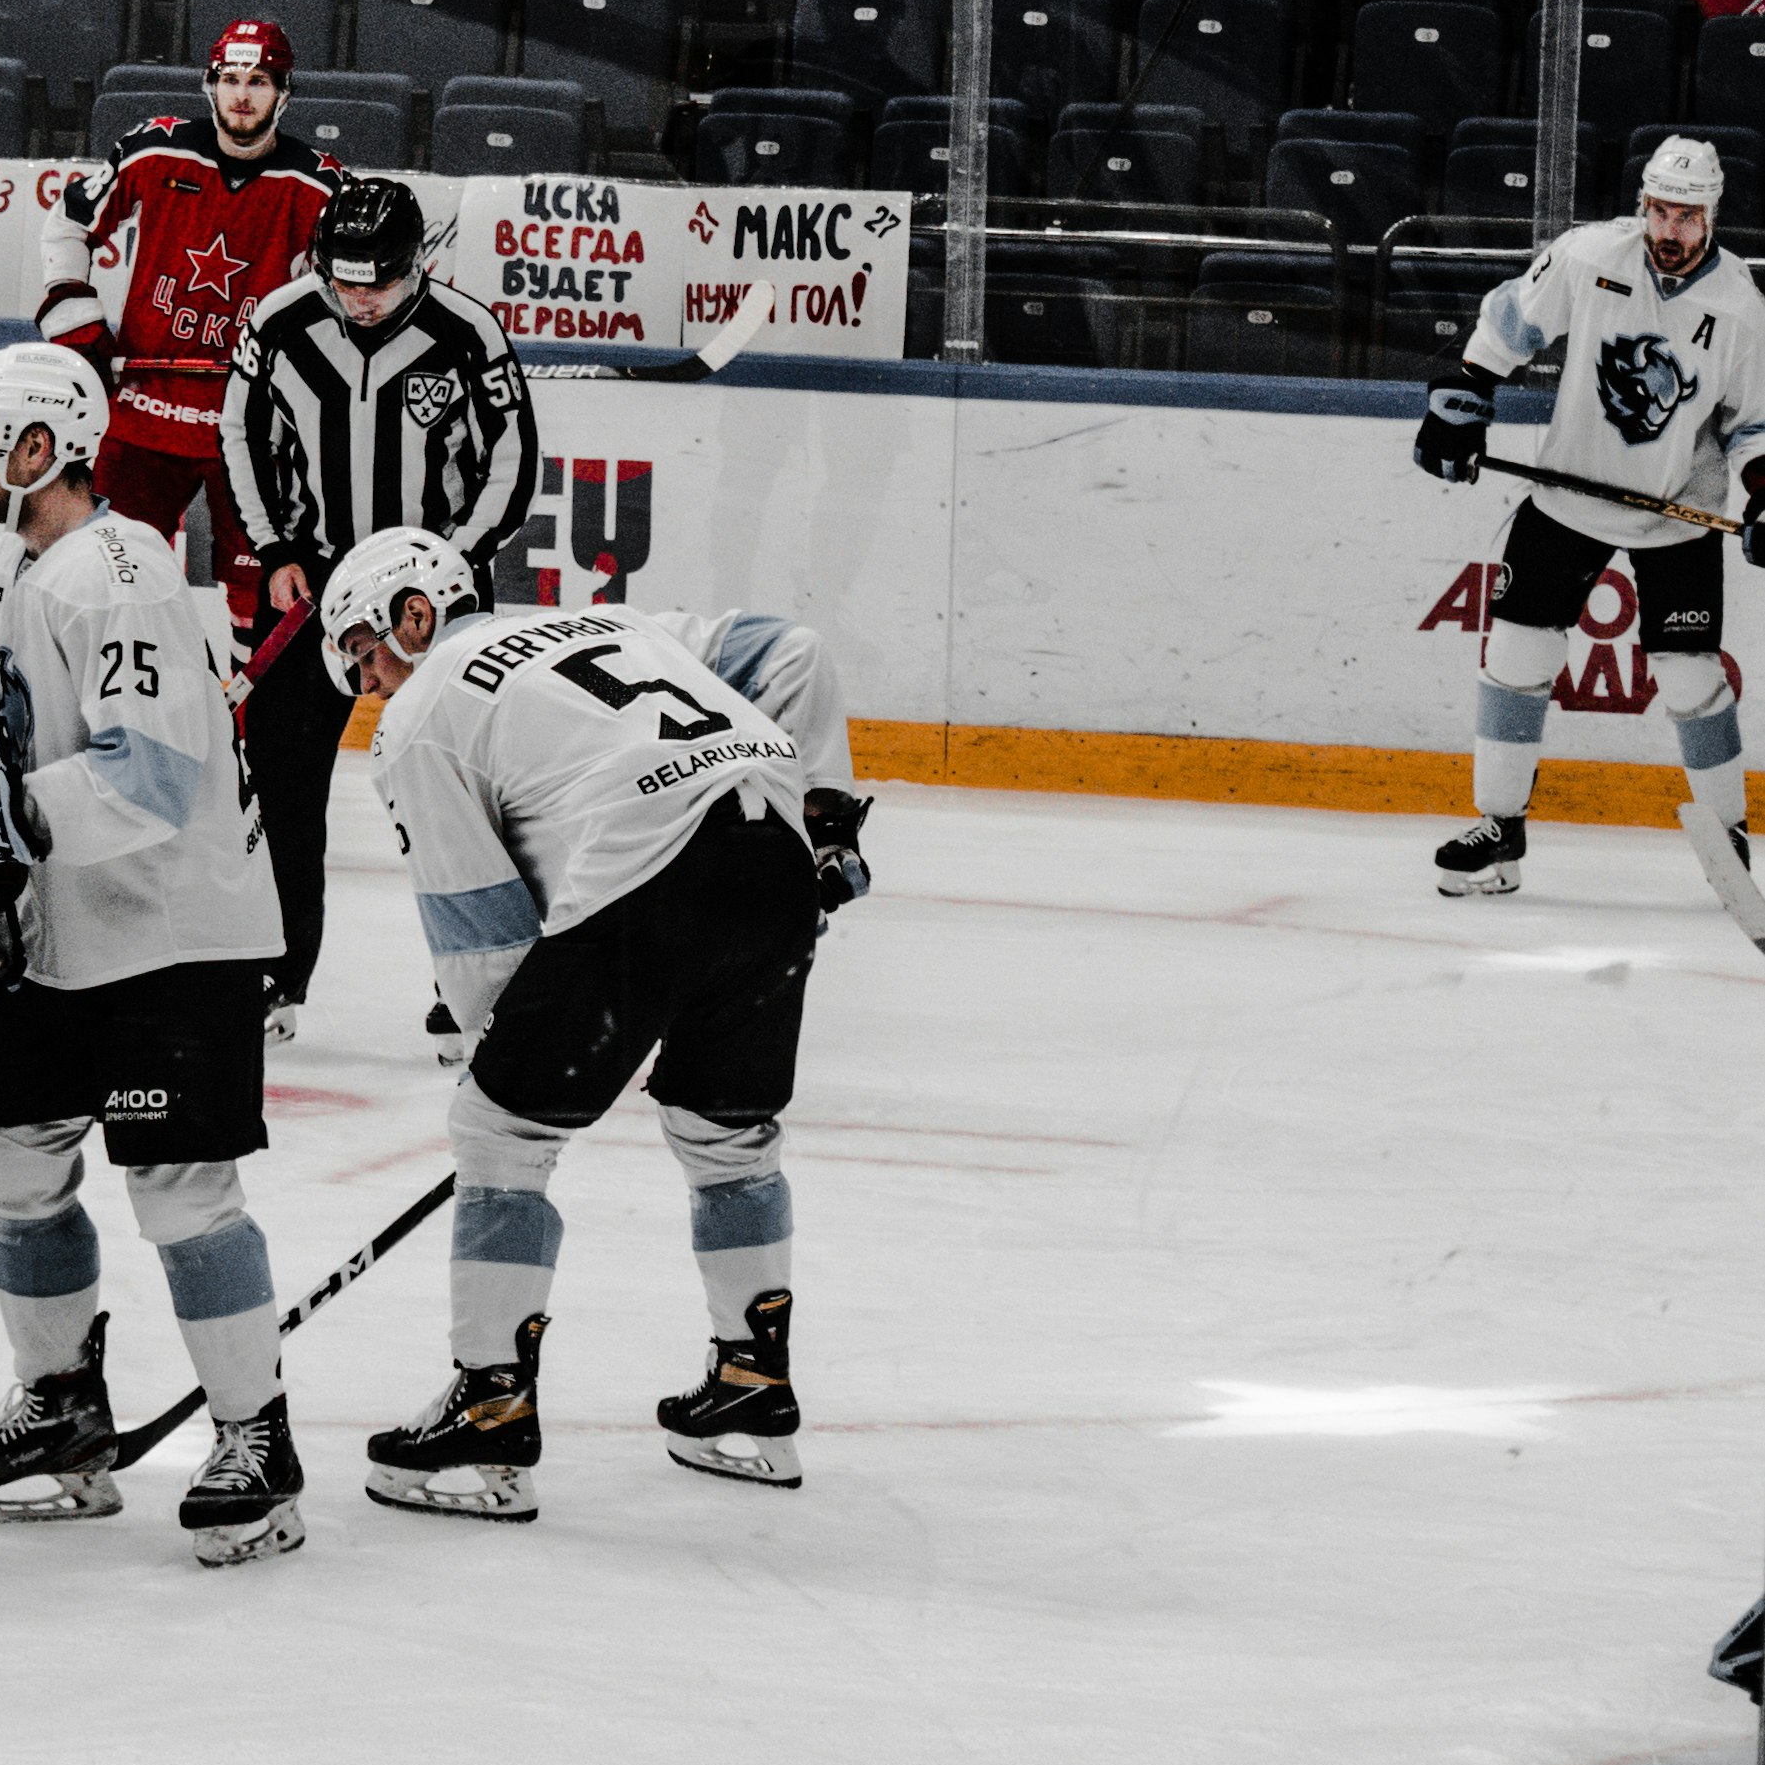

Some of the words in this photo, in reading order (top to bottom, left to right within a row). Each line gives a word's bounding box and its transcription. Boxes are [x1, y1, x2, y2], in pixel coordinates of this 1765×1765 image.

[523, 181, 621, 225] ЦСКА
[687, 200, 721, 246] 27
[863, 204, 902, 239] 27
[494, 218, 646, 265] ВСЕГДА
[501, 257, 633, 304] БУДЕТ
[789, 269, 868, 328] ГОЛ!
[489, 300, 646, 342] ПЕРВЫМ
[1690, 312, 1718, 351] A
[27, 395, 66, 406] CCM
[480, 360, 524, 410] 56
[94, 527, 136, 585] Belavia
[99, 639, 160, 701] 25
[550, 642, 737, 742] 5
[635, 741, 798, 796] BELARUSKALI
